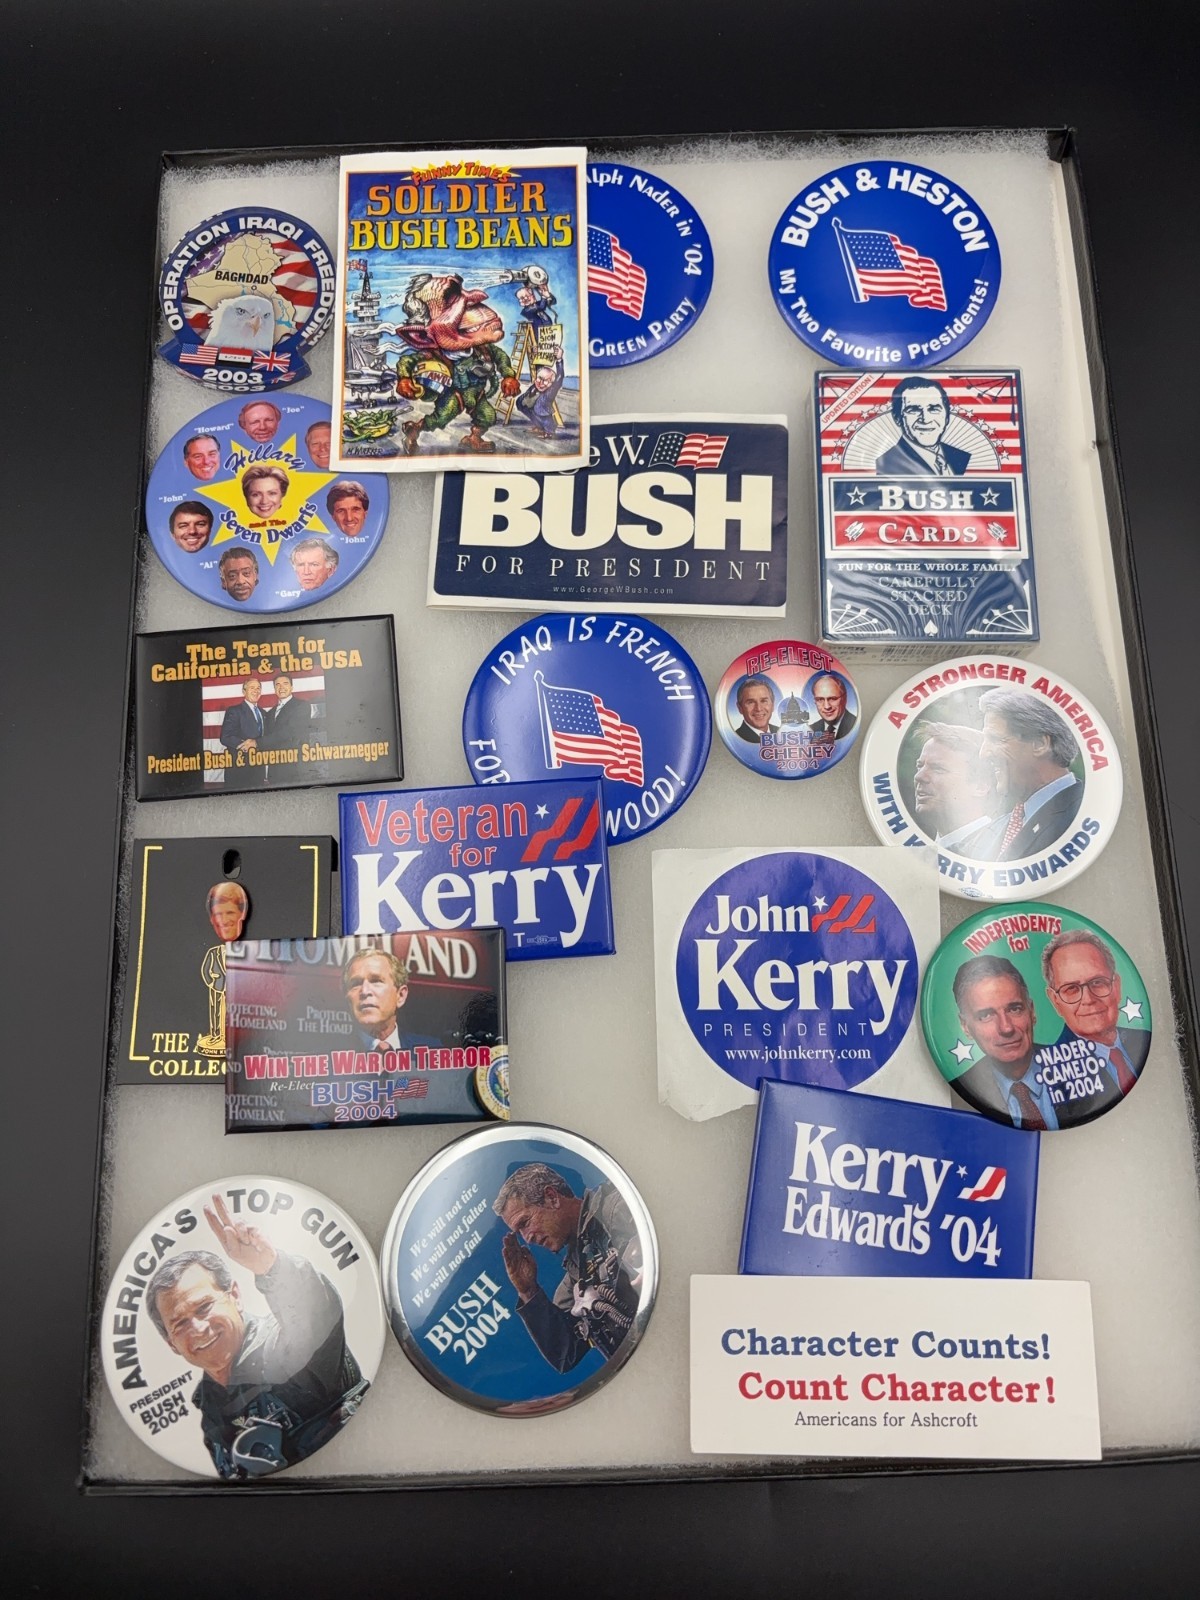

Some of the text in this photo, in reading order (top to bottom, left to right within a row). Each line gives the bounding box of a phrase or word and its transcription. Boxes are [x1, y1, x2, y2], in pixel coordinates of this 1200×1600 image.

[411, 162, 512, 186] FUNNY TIMES
[366, 182, 546, 217] SOLDIER
[780, 168, 990, 253] BUSH & HESTON
[350, 214, 574, 251] BUSH BEANS
[683, 243, 704, 276] '04
[163, 221, 230, 331] OPERATION
[238, 216, 303, 241] IRAQI
[301, 239, 335, 339] FREEDOM
[215, 271, 269, 285] BAGHDAD
[779, 268, 990, 363] My Two Favorite Presidents!
[202, 368, 263, 384] 2003
[822, 398, 849, 424] UPDATED
[223, 443, 306, 473] Hillary
[605, 434, 650, 466] W.
[459, 471, 773, 552] BUSH
[878, 485, 974, 511] BUSH
[220, 502, 318, 544] Seven Dwarfs
[249, 519, 287, 529] and The
[878, 522, 978, 544] CARDS
[455, 554, 770, 581] FOR PRESIDENT
[837, 563, 865, 572] FUN
[867, 563, 892, 572] FOR
[896, 563, 921, 572] THE
[924, 563, 970, 572] WHOLE
[878, 576, 979, 588] CAREFULLY
[553, 584, 674, 596] www.GeorgeWBush.com
[890, 590, 968, 603] STACKED
[907, 604, 953, 616] DECK
[186, 636, 326, 662] The Team for
[491, 616, 695, 701] IRAQ IS FRENCH
[745, 646, 834, 677] RE-ELECT
[151, 650, 363, 682] California & the USA
[887, 662, 1109, 772] A STRONGER AMERICA
[759, 745, 835, 761] CHENEY
[760, 731, 812, 747] BUSH
[147, 741, 389, 774] President Bush & Governor Schwarznegger
[469, 738, 511, 784] FOR
[777, 759, 820, 771] 2004
[356, 798, 528, 847] Veteran
[872, 771, 909, 835] WITH
[993, 816, 1100, 887] EDWARDS
[449, 842, 497, 868] for
[351, 850, 603, 949] Kerry
[705, 894, 811, 935] John
[962, 913, 1062, 956] INDEPENDENTS
[1007, 935, 1030, 953] for
[694, 938, 911, 1036] Kerry
[298, 1018, 318, 1033] THE
[704, 1022, 867, 1037] PRESIDENT
[152, 1032, 189, 1053] THE
[724, 1045, 872, 1064] www.johnkerry.com
[244, 1055, 289, 1080] WIN
[291, 1055, 329, 1078] THE
[331, 1049, 380, 1075] WAR
[382, 1050, 411, 1073] ON
[414, 1045, 492, 1070] TERROR
[270, 1081, 316, 1092] Re-Elect
[311, 1077, 395, 1107] BUSH
[1050, 1075, 1104, 1104] in 2004
[335, 1104, 397, 1122] 2004
[789, 1121, 953, 1219] Kerry
[409, 1182, 479, 1259] We will not tire
[782, 1186, 1002, 1267] Edwards '04
[410, 1198, 488, 1283] We will not falter
[411, 1231, 483, 1310] We will not fail
[112, 1188, 360, 1391] AMERICA'S TOP GUN
[423, 1271, 503, 1355] BUSH
[453, 1299, 511, 1365] 2004
[720, 1327, 1051, 1360] Character Counts!
[129, 1370, 193, 1414] PRESIDENT
[737, 1372, 1057, 1404] Count Character!
[139, 1390, 186, 1426] BUSH
[149, 1404, 190, 1436] 2004
[794, 1411, 978, 1428] Americans for Ashcroft
